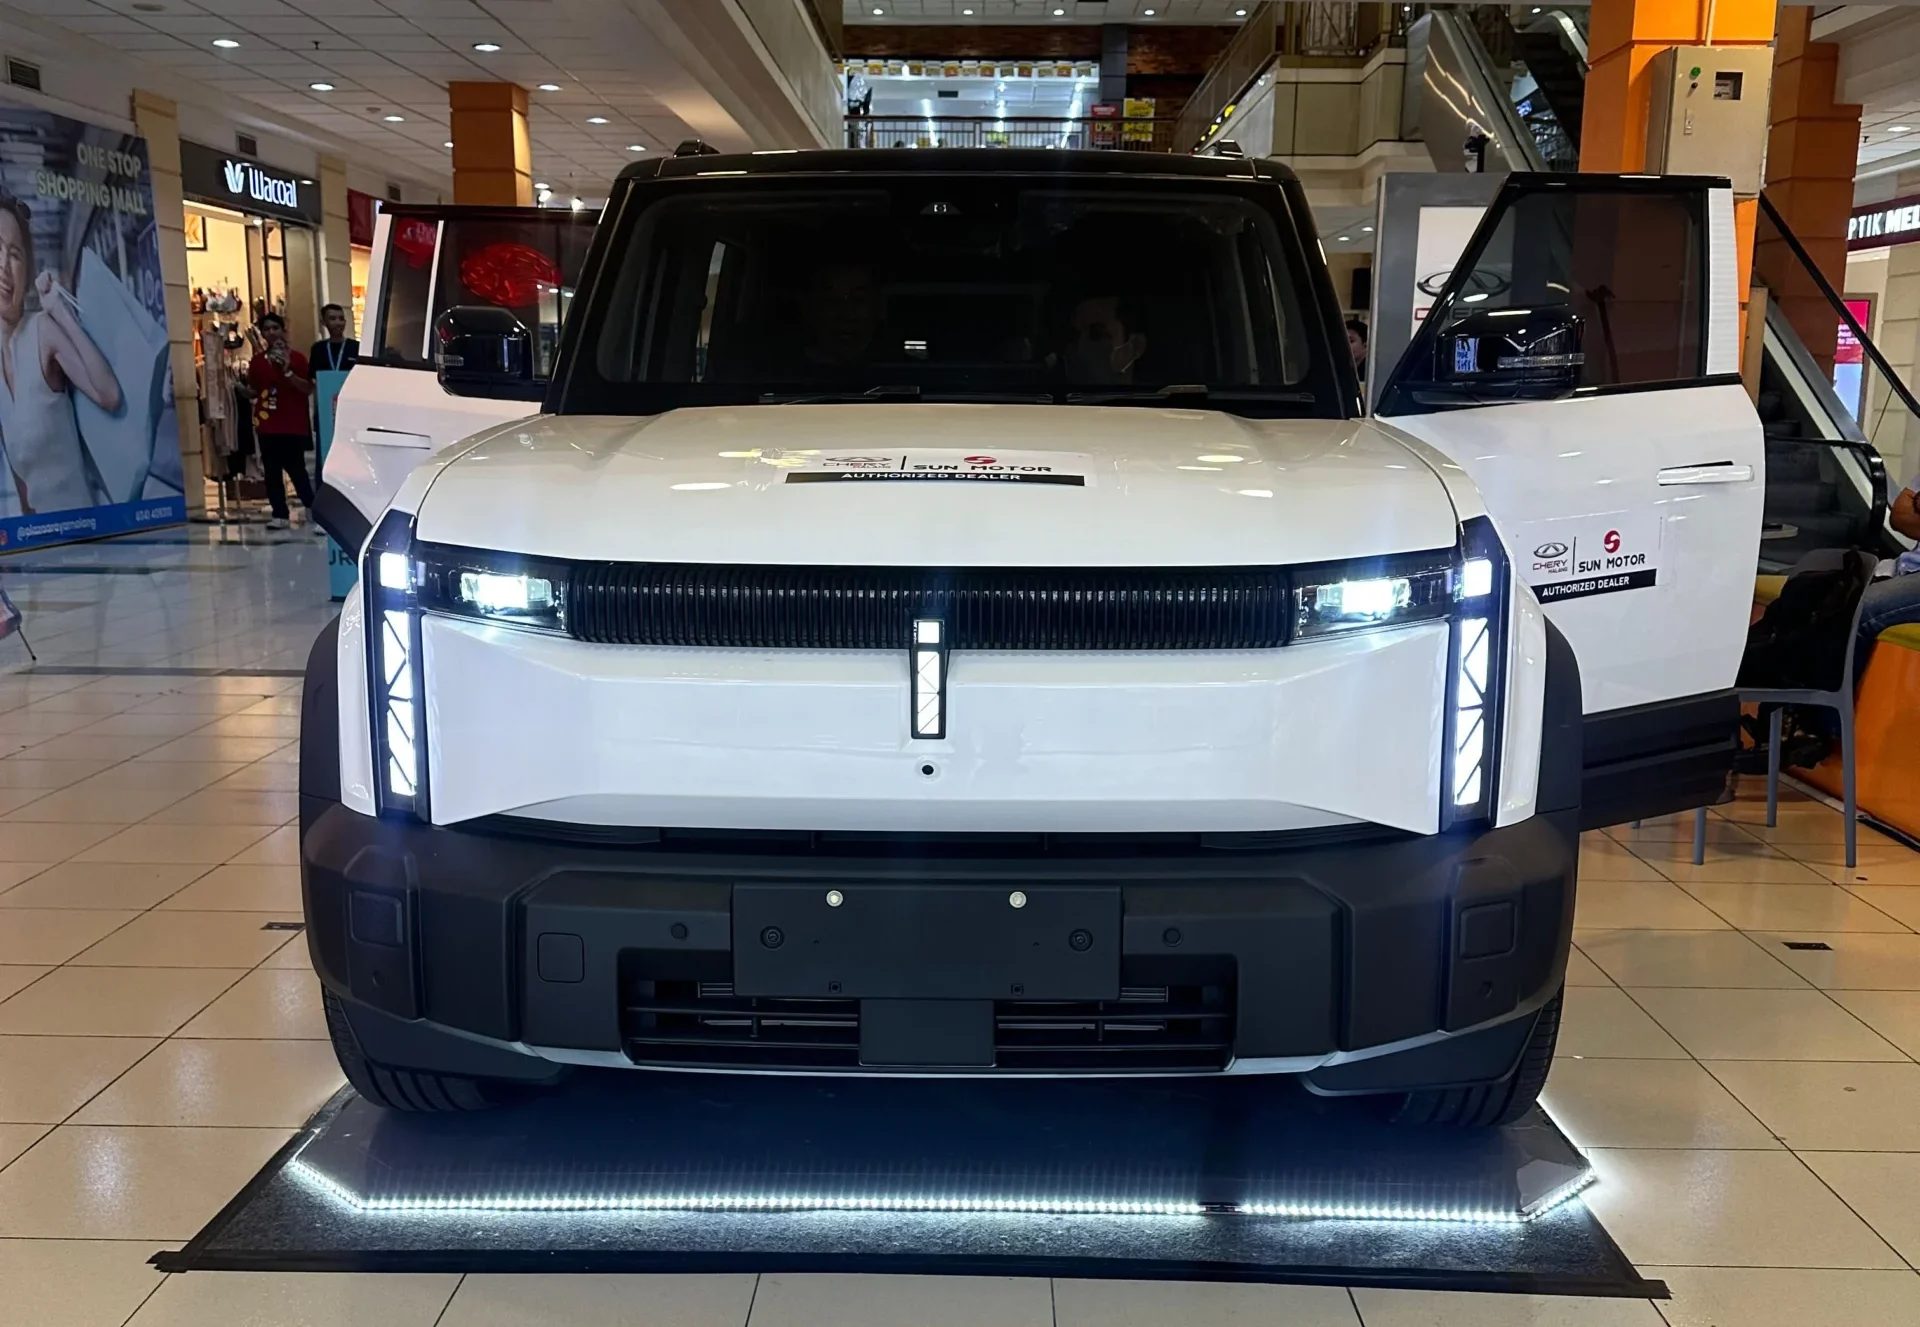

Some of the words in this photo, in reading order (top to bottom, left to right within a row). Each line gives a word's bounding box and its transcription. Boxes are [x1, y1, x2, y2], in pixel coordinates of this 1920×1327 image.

[77, 142, 107, 169] ONE
[107, 150, 142, 178] STOP
[37, 168, 111, 208] SHOPPING
[111, 186, 147, 215] MALL
[248, 167, 298, 208] Wacoal
[1847, 212, 1884, 240] PTIK
[1532, 559, 1568, 571] CHERY
[1578, 559, 1601, 573] SUN
[1606, 553, 1646, 569] MOTOR
[1542, 582, 1596, 597] AUTHORIZED
[1597, 576, 1630, 589] DEALER
